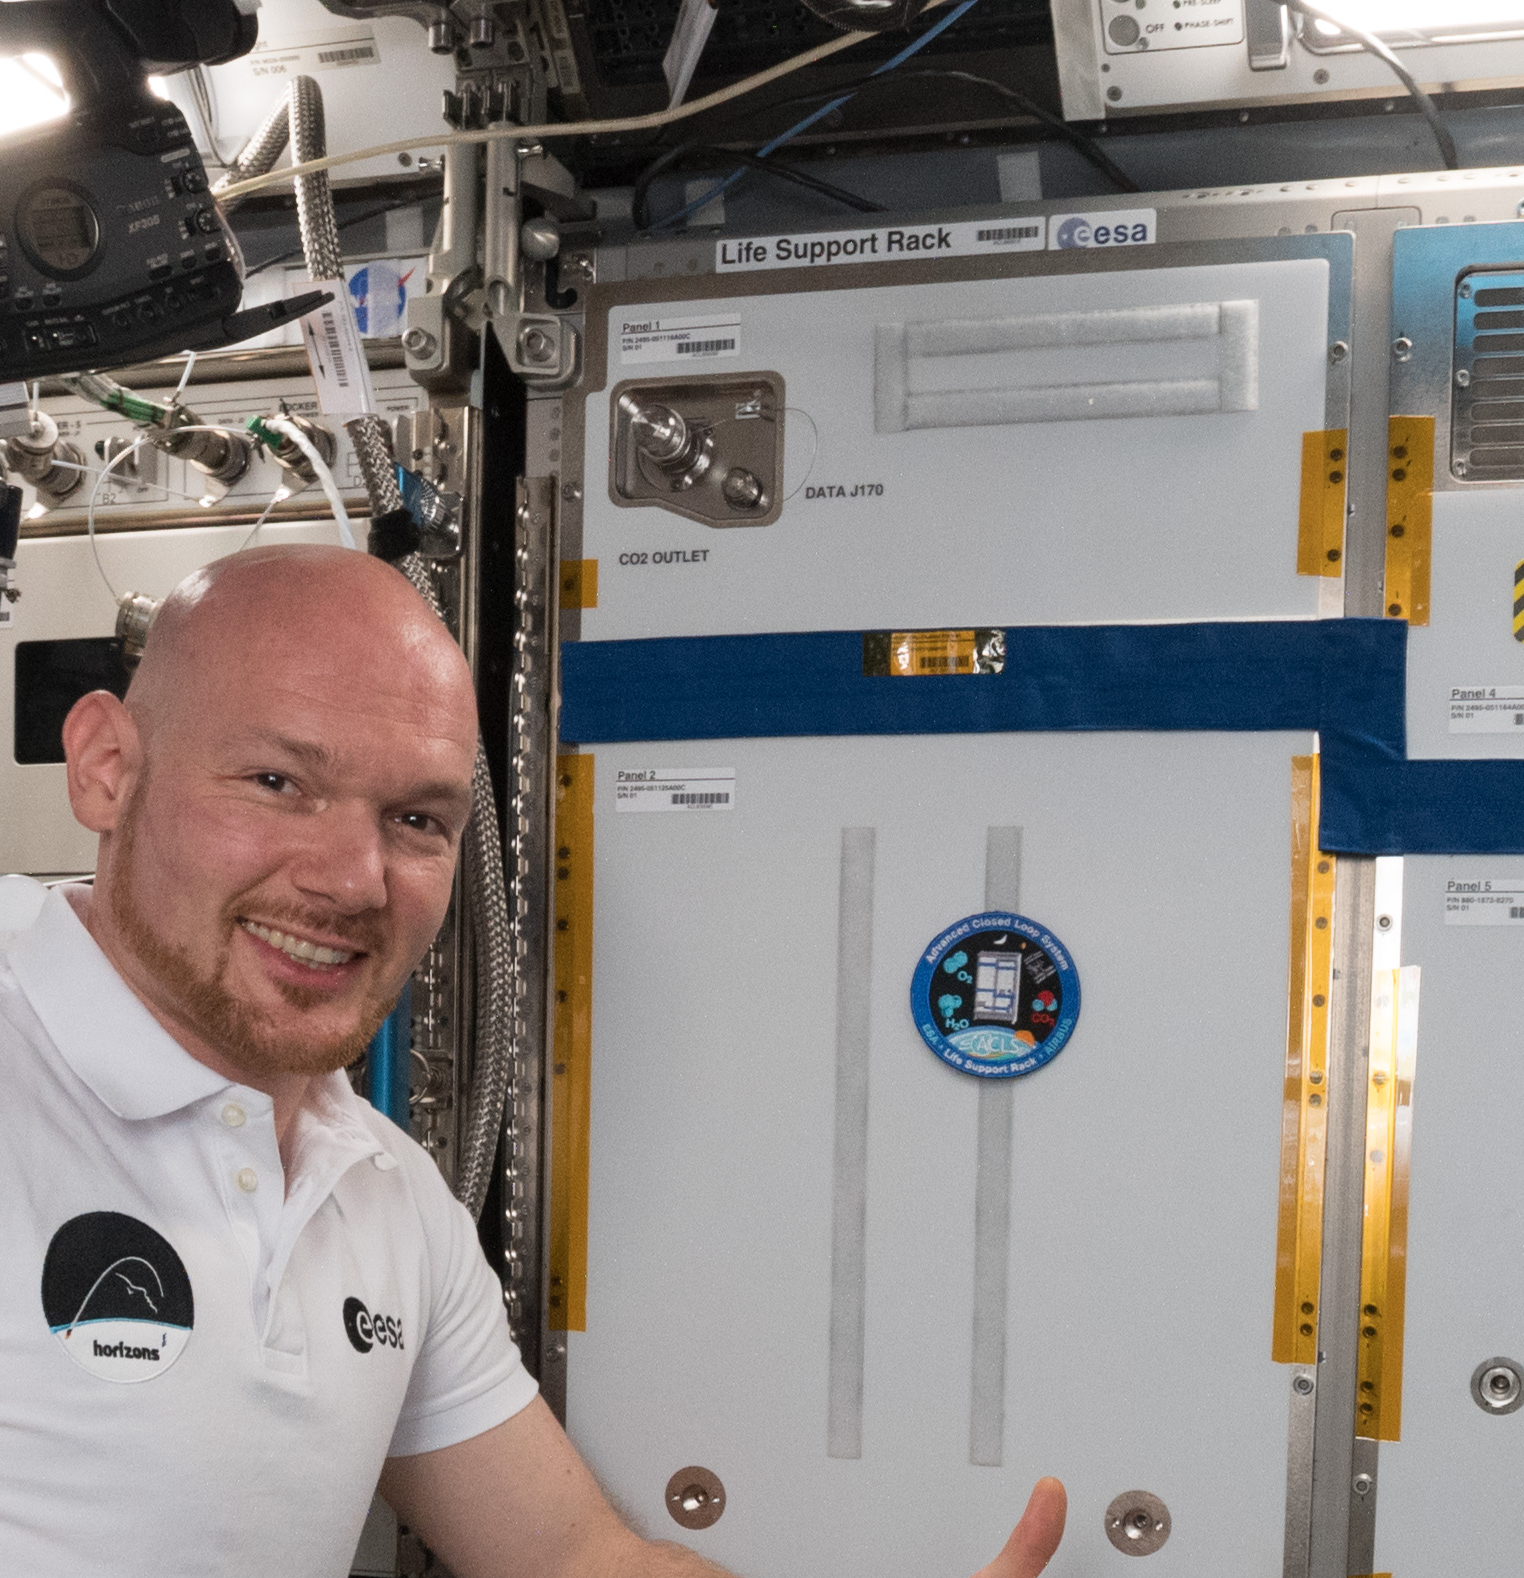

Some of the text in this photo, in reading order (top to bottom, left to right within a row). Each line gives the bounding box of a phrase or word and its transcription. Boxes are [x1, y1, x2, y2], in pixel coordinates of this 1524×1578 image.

[1146, 24, 1165, 34] OFF
[720, 227, 952, 266] Life Support Rack
[622, 322, 652, 332] Panel
[805, 484, 884, 500] DATA J170
[619, 549, 710, 565] CO2 OUTLET
[1452, 689, 1485, 699] Panel
[618, 771, 647, 780] Panel
[1447, 881, 1481, 891] Panel
[926, 917, 1069, 971] Advanced Closed Loop System
[922, 1023, 938, 1045] ESA
[1045, 1018, 1073, 1056] AIRBUS
[943, 1049, 1037, 1075] Life Support Rack
[93, 1339, 160, 1361] horizons
